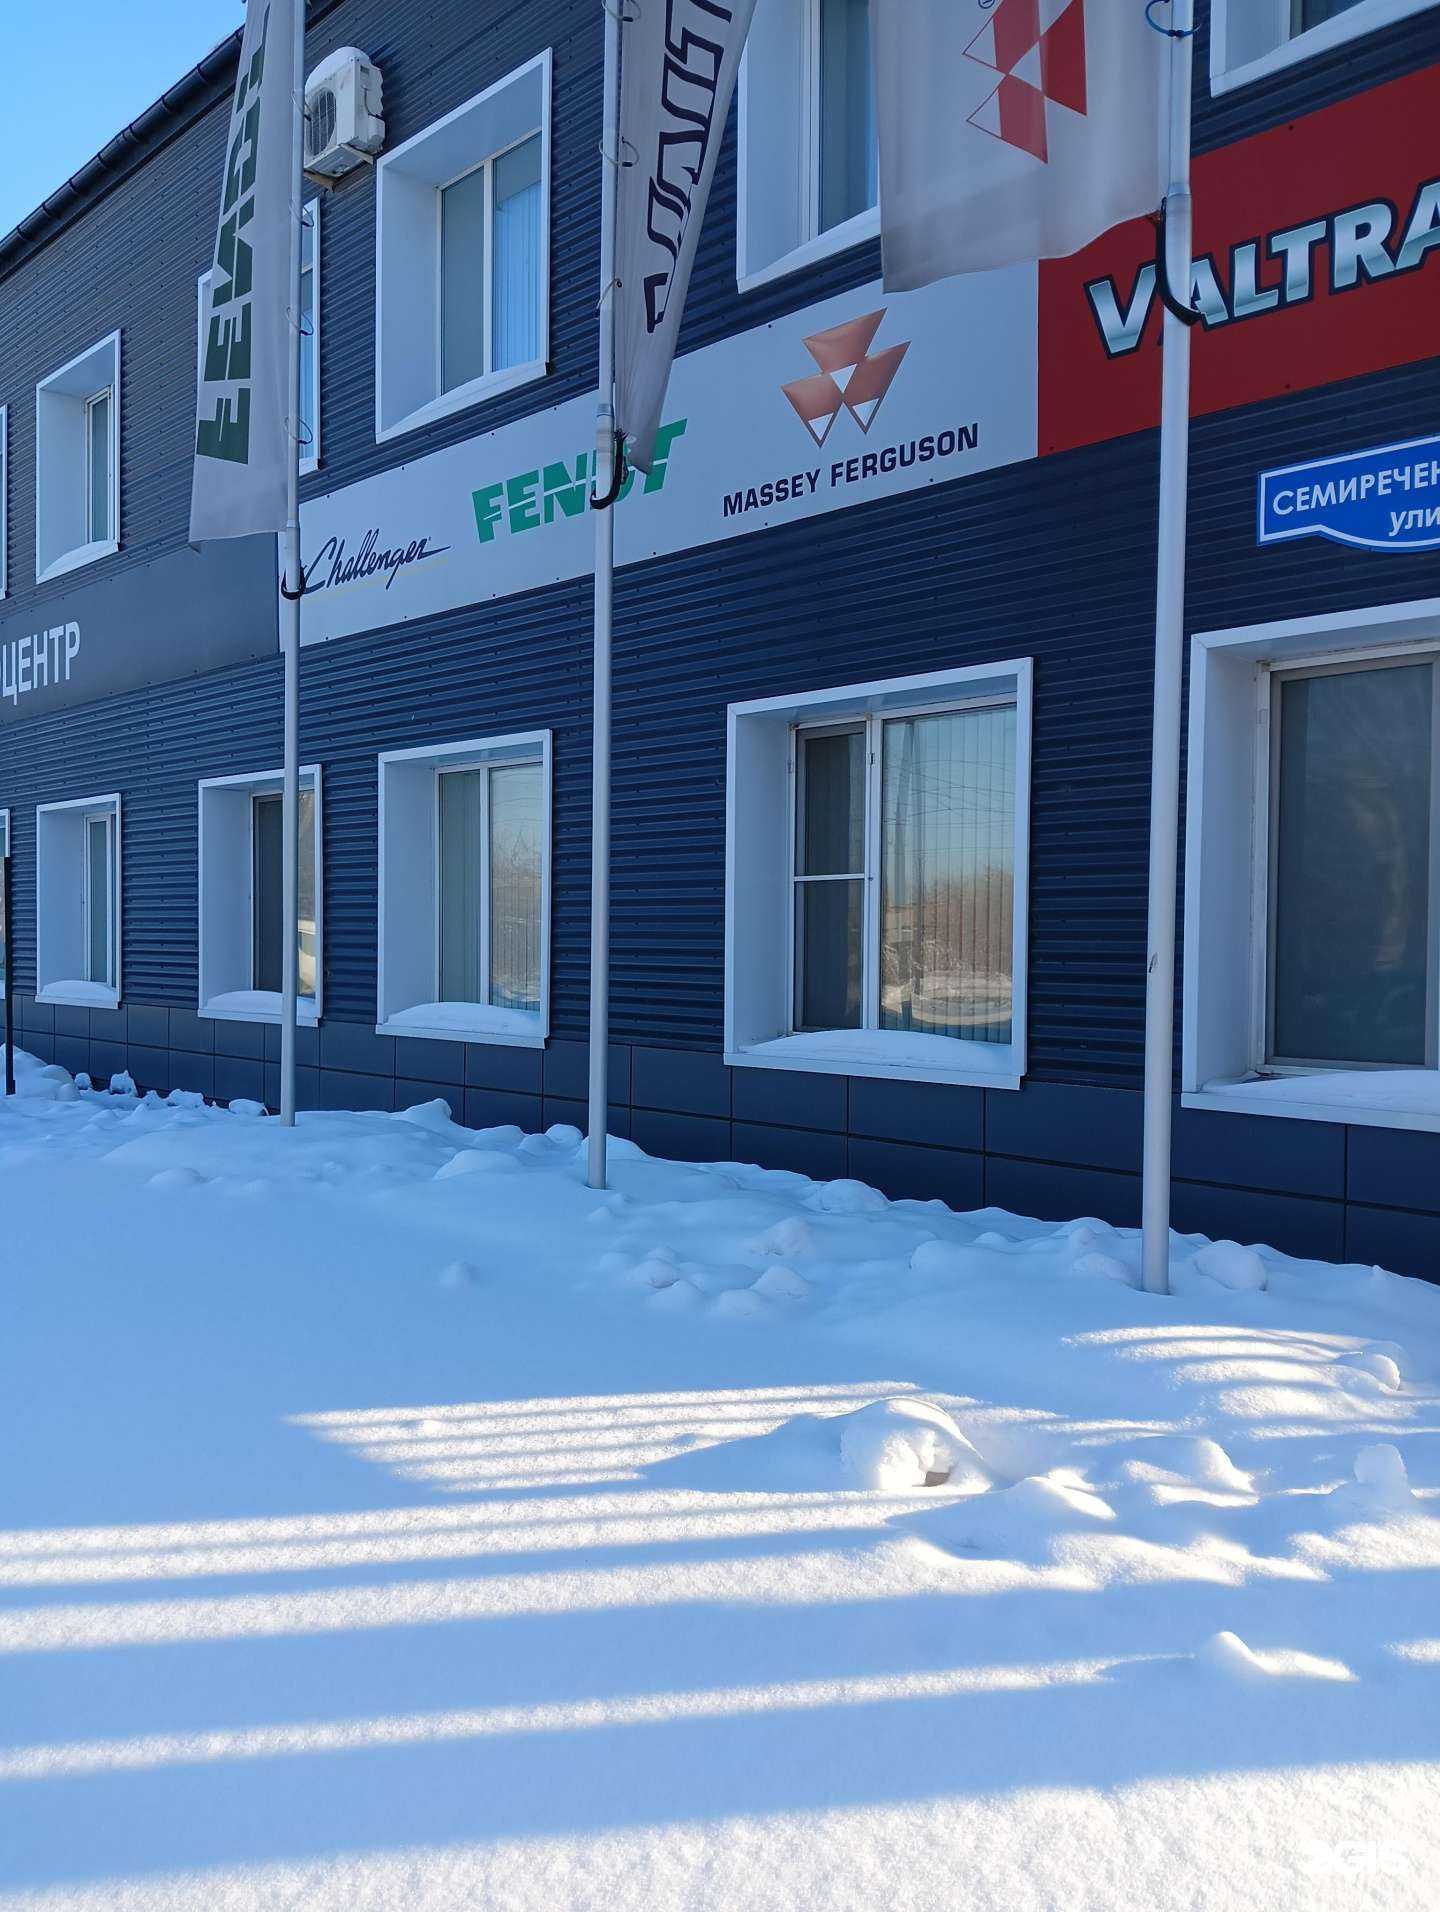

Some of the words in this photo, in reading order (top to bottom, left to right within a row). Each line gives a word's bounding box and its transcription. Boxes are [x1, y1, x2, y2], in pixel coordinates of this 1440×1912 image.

[722, 468, 822, 518] MASSEY
[830, 422, 979, 488] FERGUSON
[303, 528, 452, 595] Challenger
[0, 621, 81, 706] ЦЕНТР
